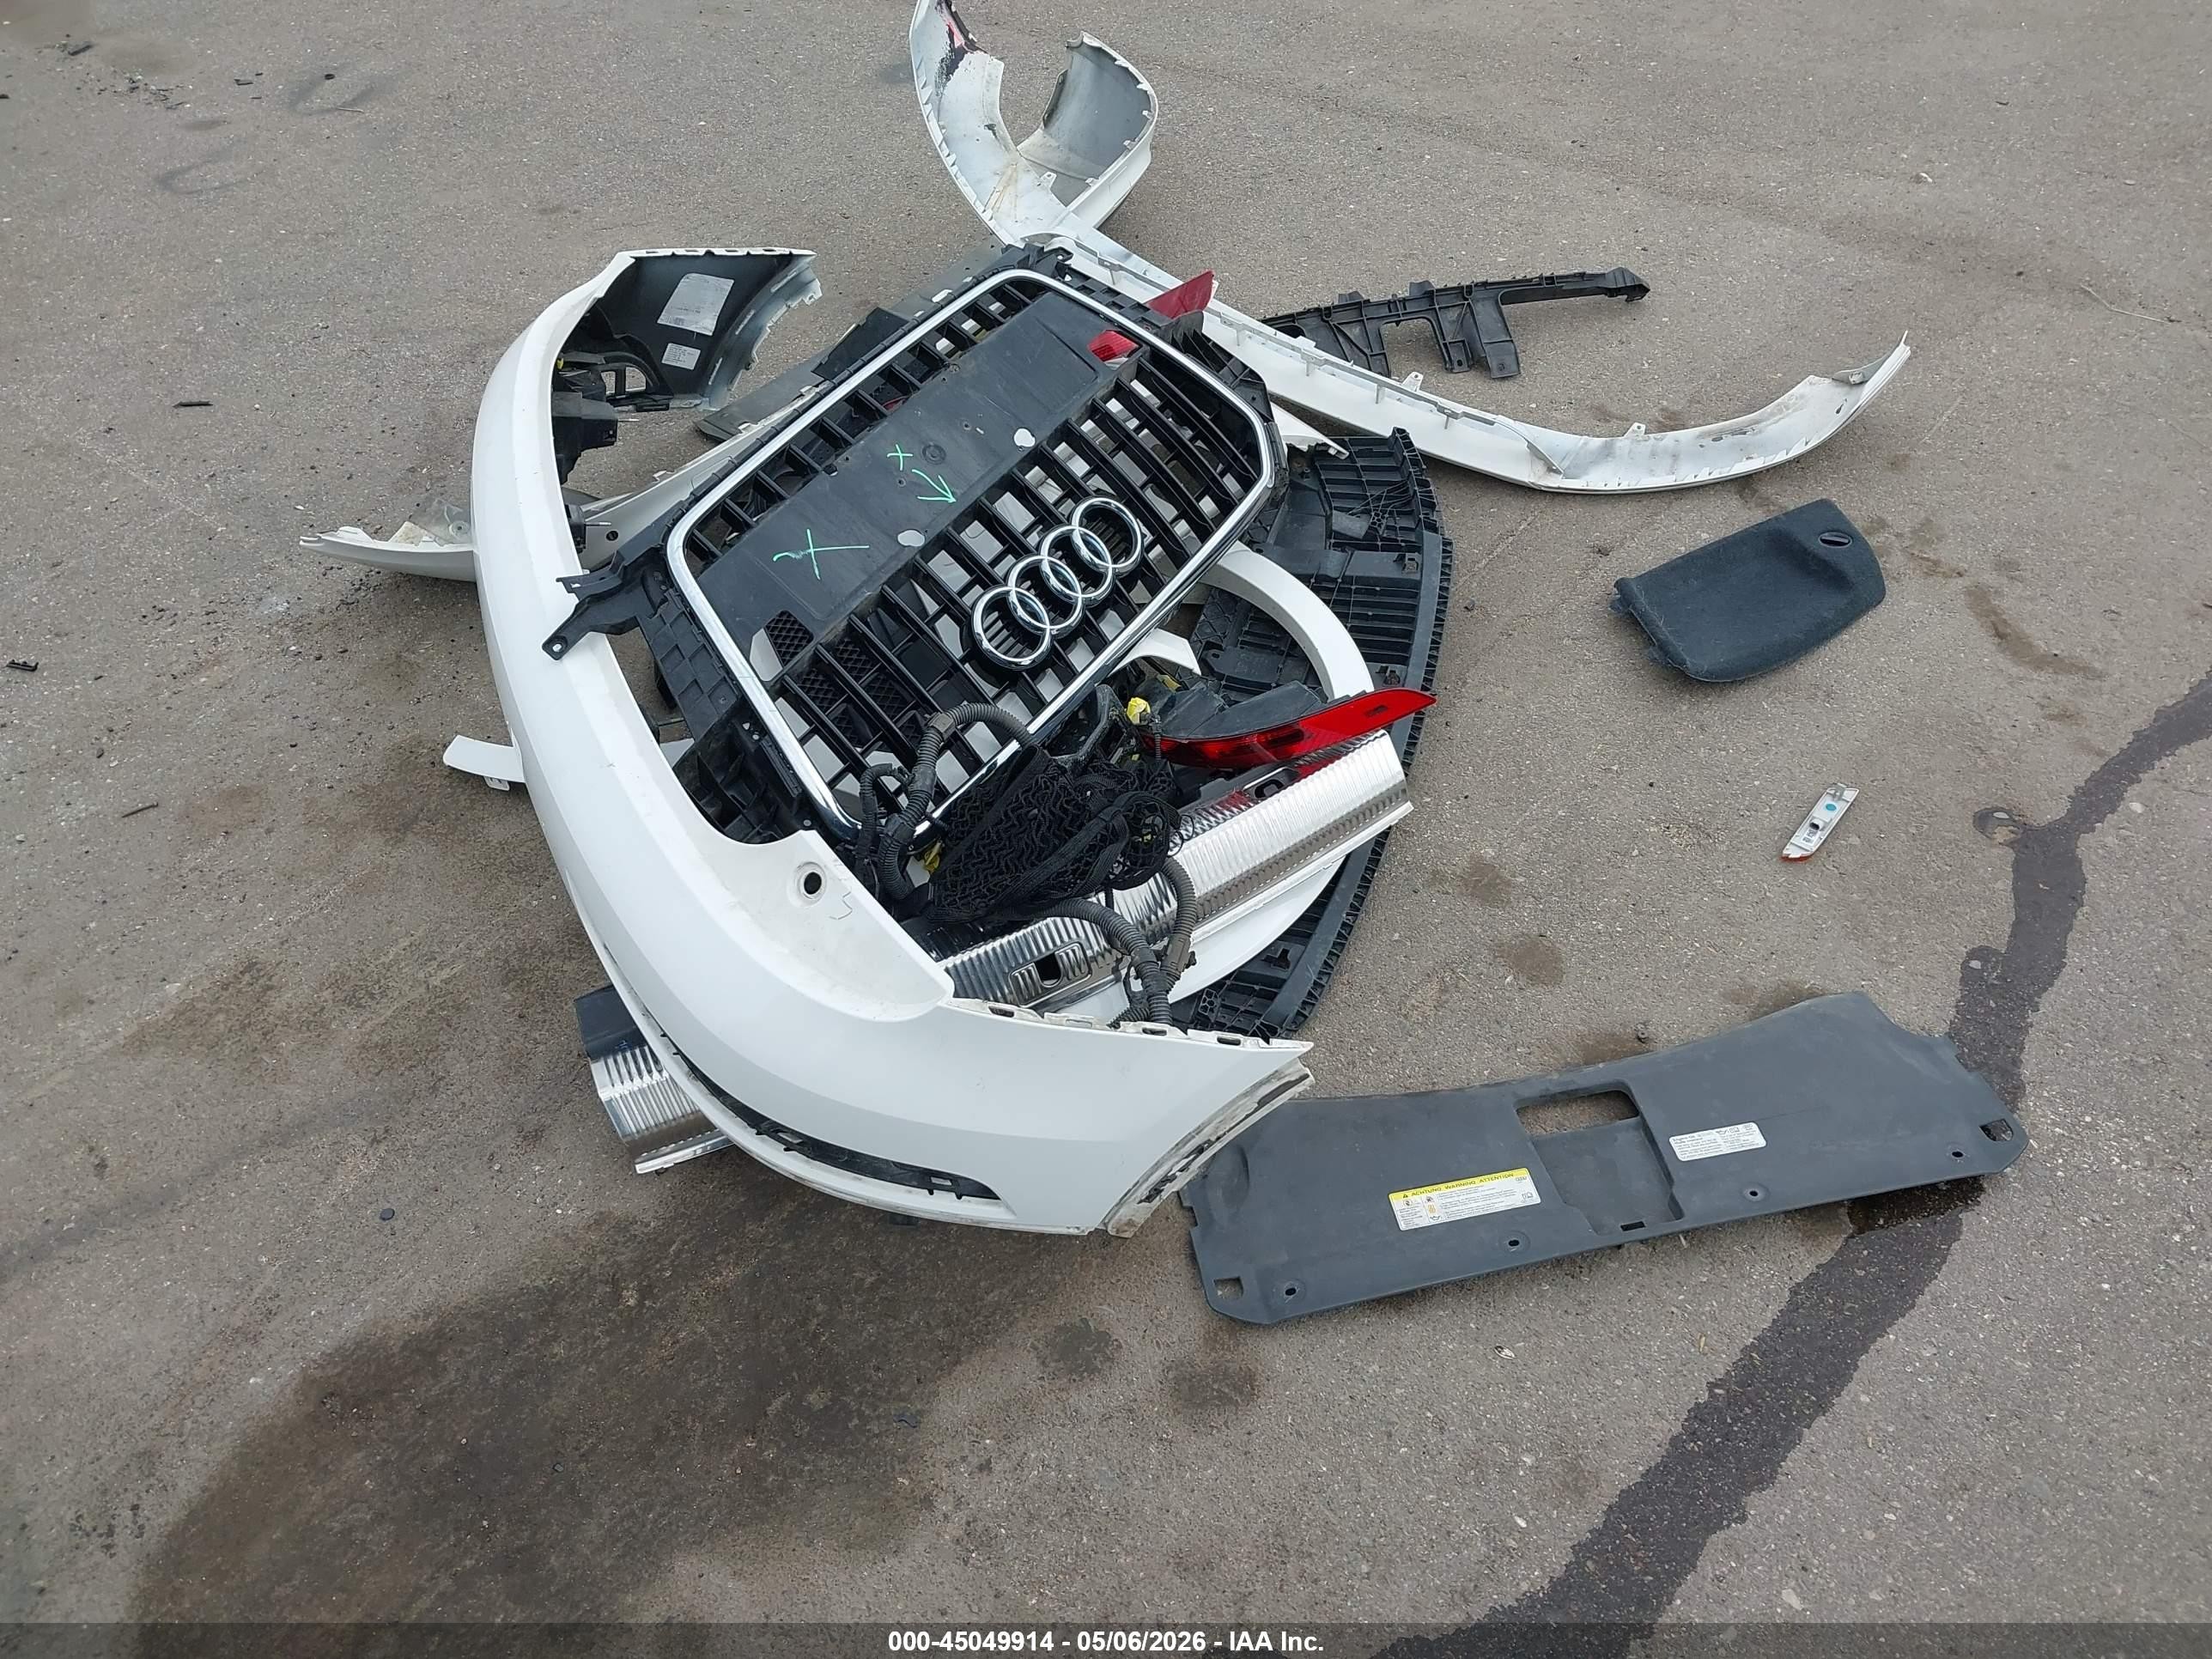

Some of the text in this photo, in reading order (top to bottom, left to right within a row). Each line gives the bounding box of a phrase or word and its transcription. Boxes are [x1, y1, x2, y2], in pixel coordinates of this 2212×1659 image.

[1411, 1173, 1514, 1196] ACHTUNG WARNING ATTENTION
